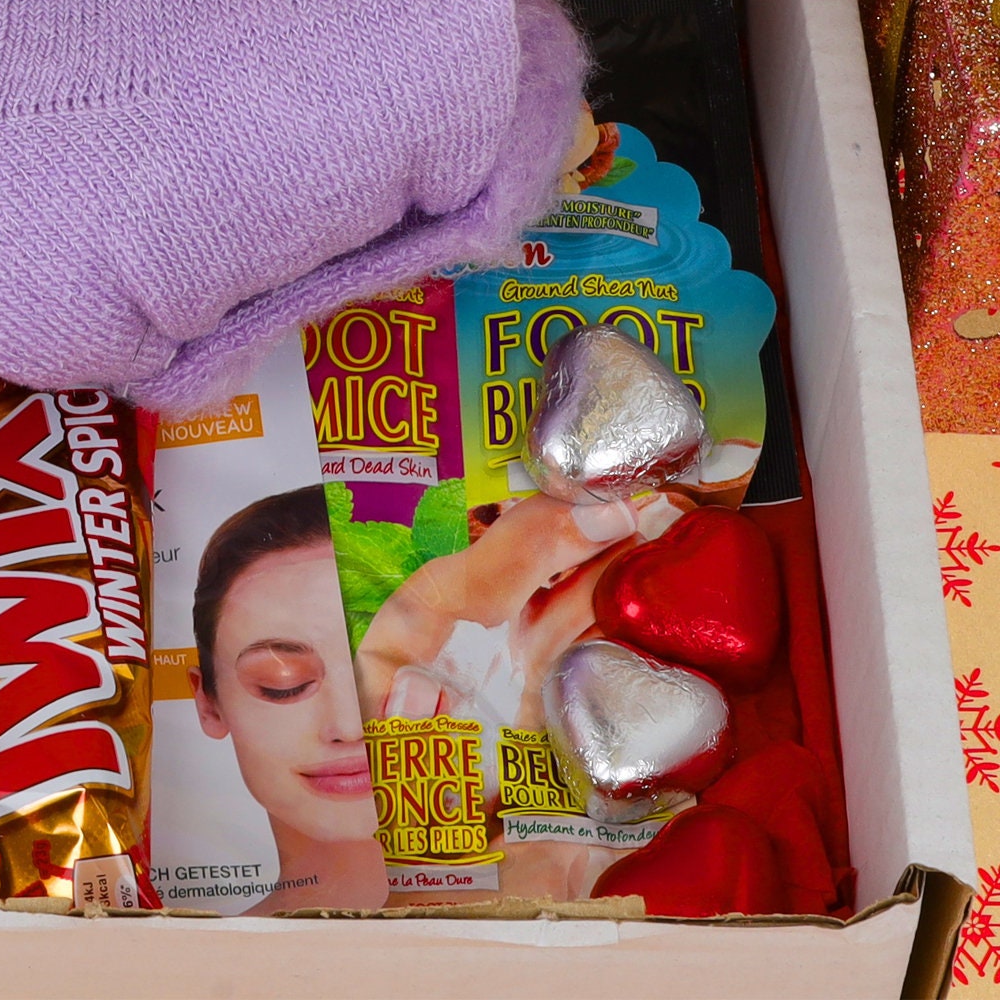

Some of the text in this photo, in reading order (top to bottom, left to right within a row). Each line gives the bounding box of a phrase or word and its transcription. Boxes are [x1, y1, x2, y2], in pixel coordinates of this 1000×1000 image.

[565, 214, 581, 228] EN
[501, 275, 679, 301] Ground Shea Nut
[311, 376, 440, 448] MICE
[161, 418, 254, 442] NOUVEAU
[321, 456, 433, 479] ard Dead Skin
[57, 389, 147, 662] WINTER SPIC
[153, 654, 188, 666] HAUT
[389, 718, 433, 734] Poivrée
[436, 716, 481, 733] Pressée
[502, 728, 537, 743] Baies
[366, 736, 482, 782] IERRE
[374, 780, 486, 824] ONCE
[504, 786, 557, 808] POUR
[397, 829, 428, 854] LES
[432, 827, 487, 852] PIEDS
[507, 820, 657, 843] Hydratant en Profonde
[175, 864, 262, 881] GETESTET
[401, 874, 413, 887] la
[414, 872, 443, 887] Peau
[446, 873, 474, 886] Dure
[83, 881, 95, 903] 4kJ
[168, 874, 319, 900] dermatologiquement
